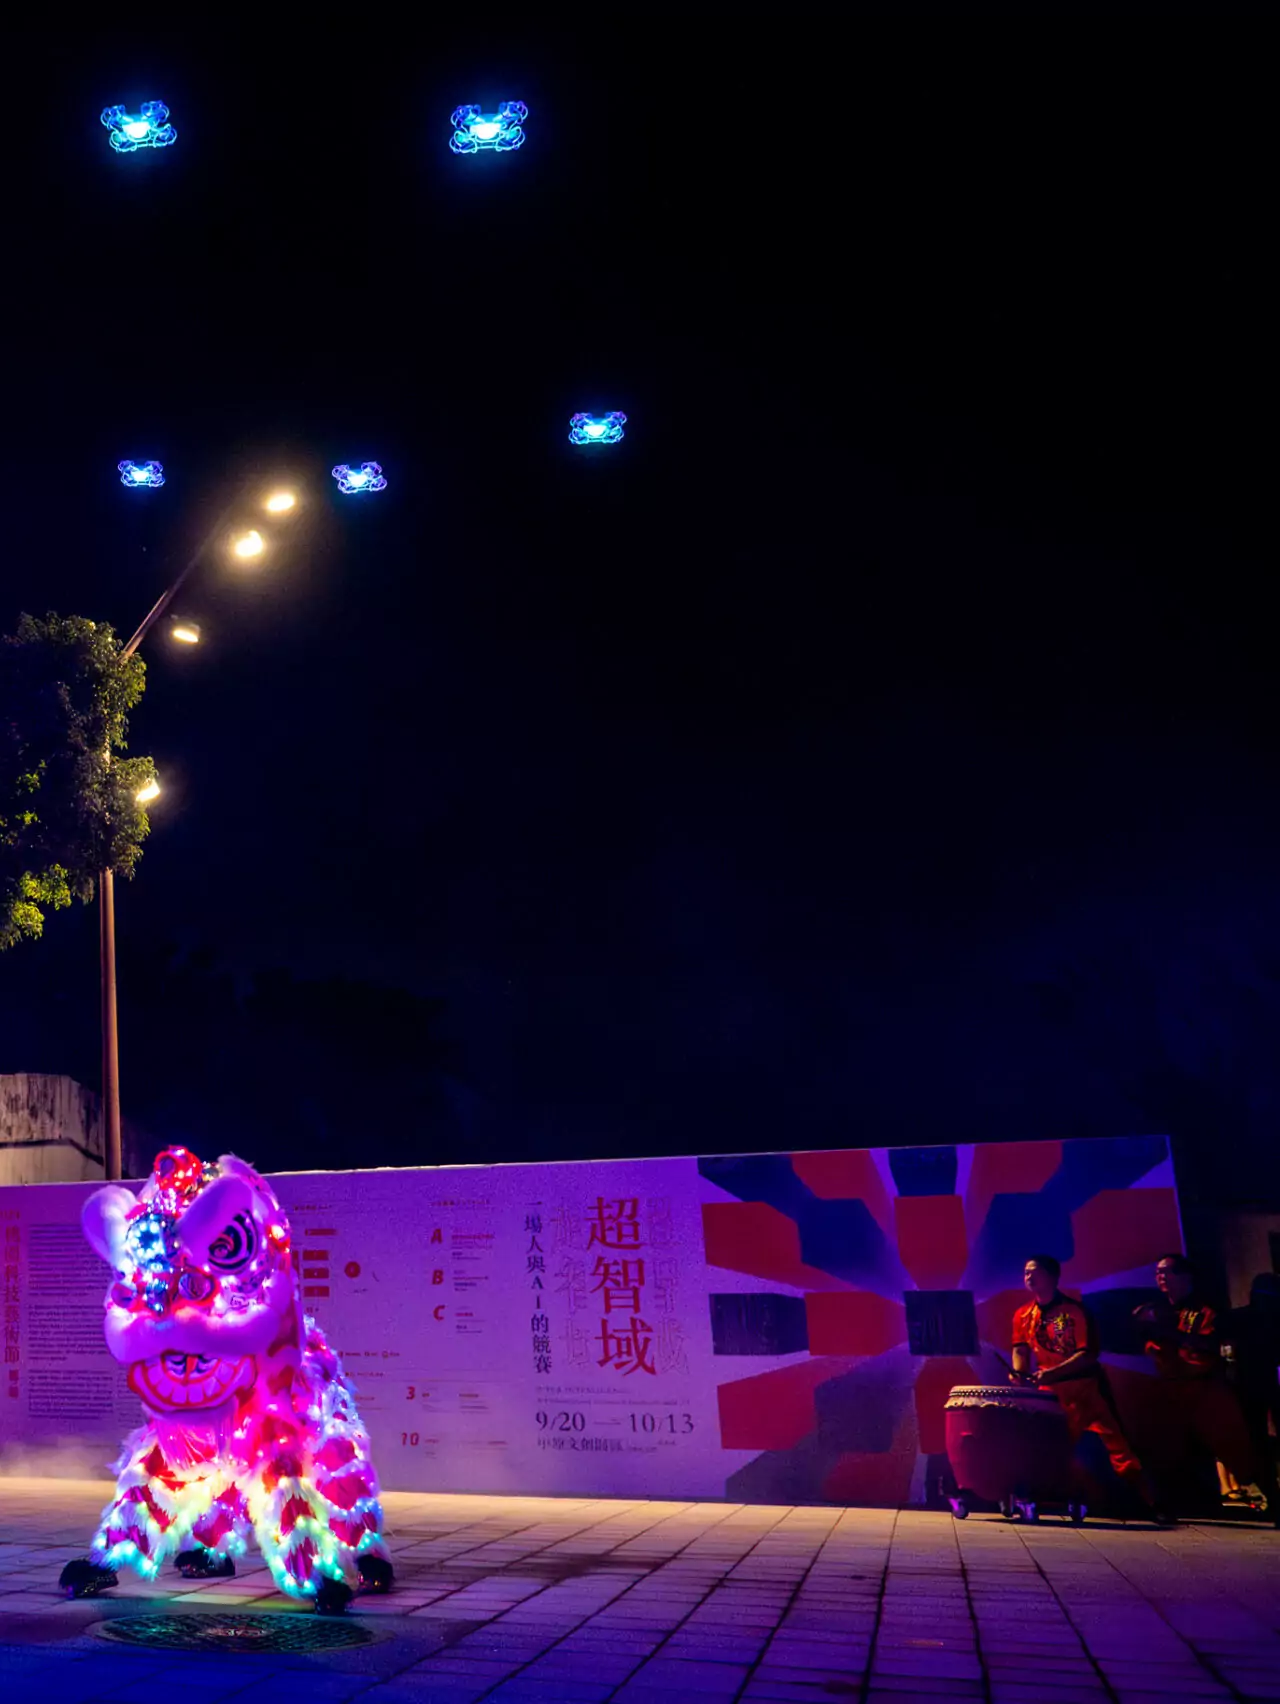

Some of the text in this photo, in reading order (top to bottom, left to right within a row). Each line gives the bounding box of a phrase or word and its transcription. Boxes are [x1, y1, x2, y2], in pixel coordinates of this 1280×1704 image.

[430, 1227, 443, 1244] A
[432, 1269, 444, 1285] B
[524, 1201, 552, 1375] 一場人與AI的競賽
[584, 1196, 657, 1376] 超智域
[433, 1304, 445, 1321] C
[405, 1385, 416, 1400] 3
[535, 1410, 586, 1432] 9/20
[628, 1412, 695, 1434] 10/13
[401, 1431, 420, 1446] 10
